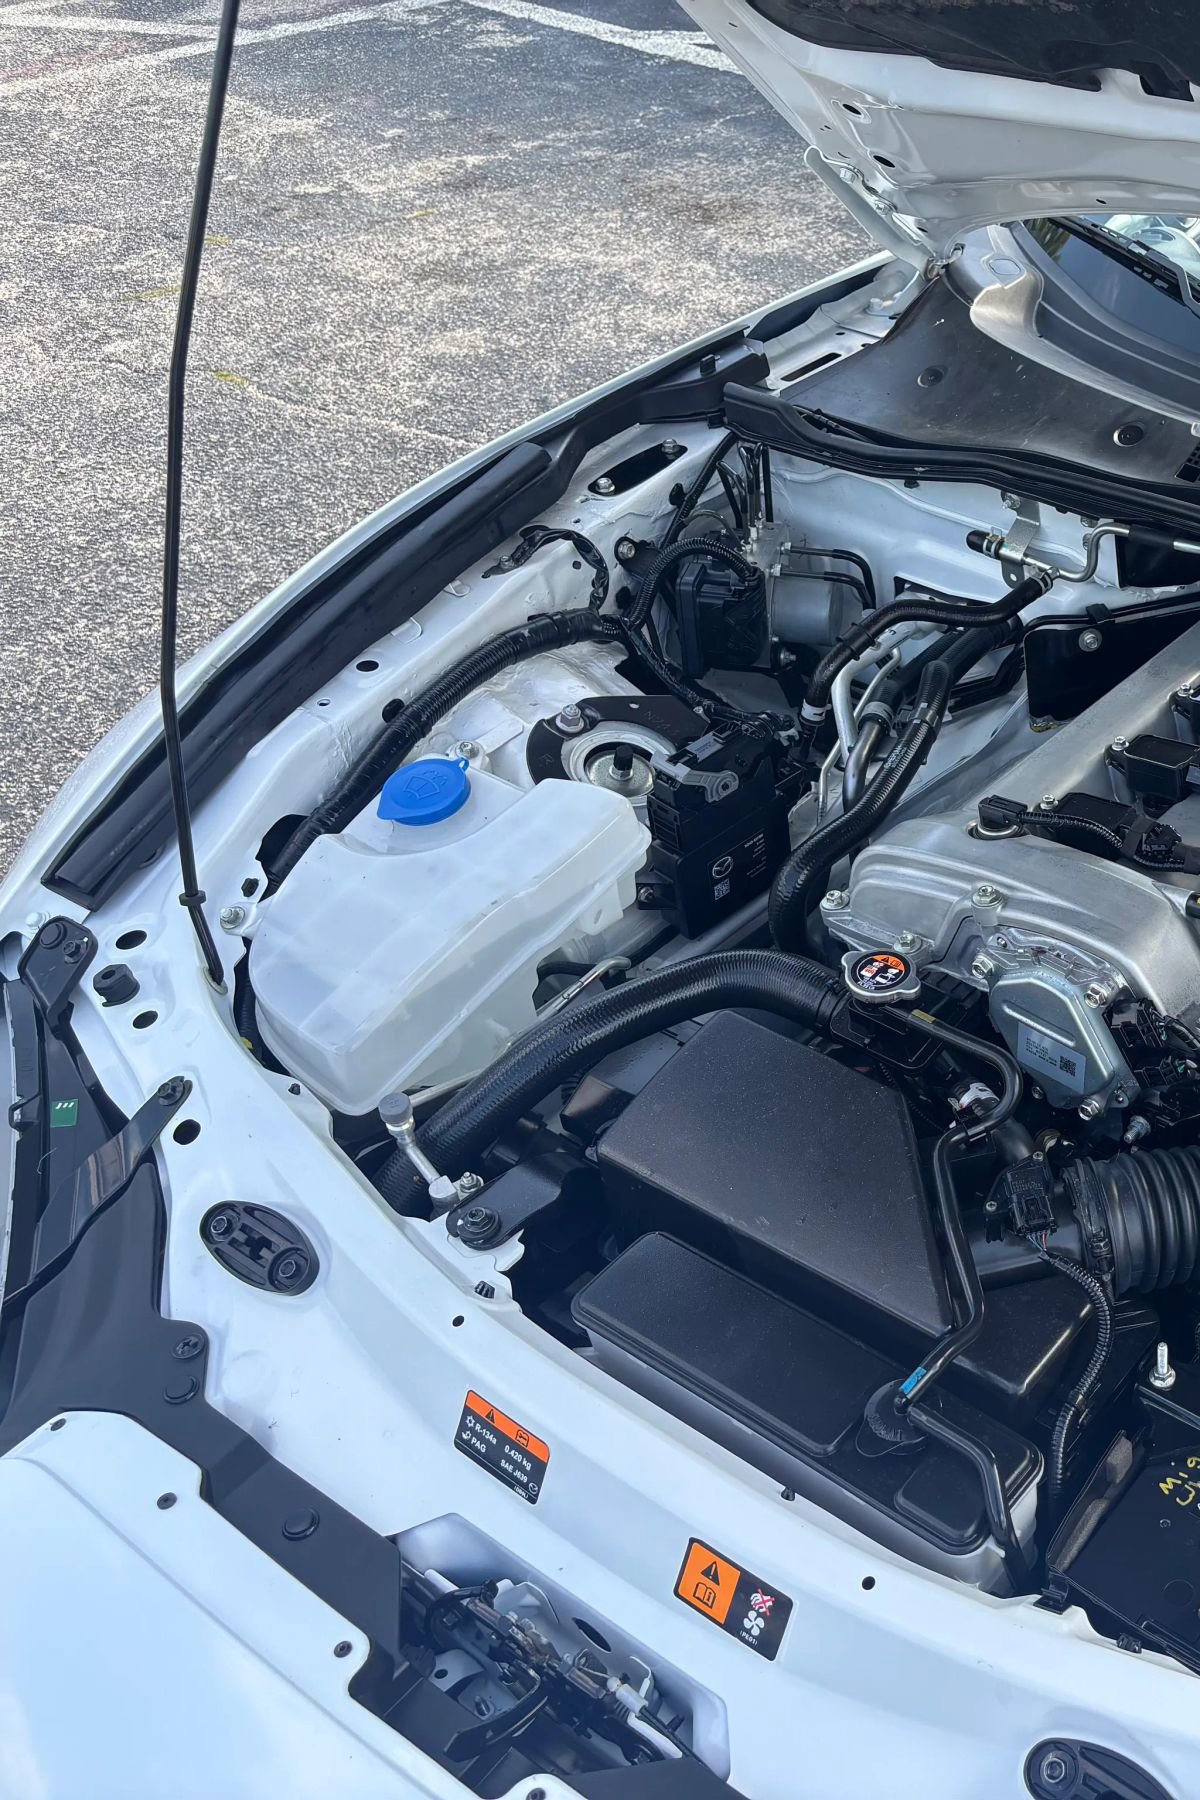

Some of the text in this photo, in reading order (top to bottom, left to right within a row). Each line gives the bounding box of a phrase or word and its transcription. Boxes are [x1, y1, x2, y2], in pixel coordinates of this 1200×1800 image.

[471, 1437, 528, 1483] PAG SAE J639
[475, 1423, 532, 1471] R-134a 0.420 kg
